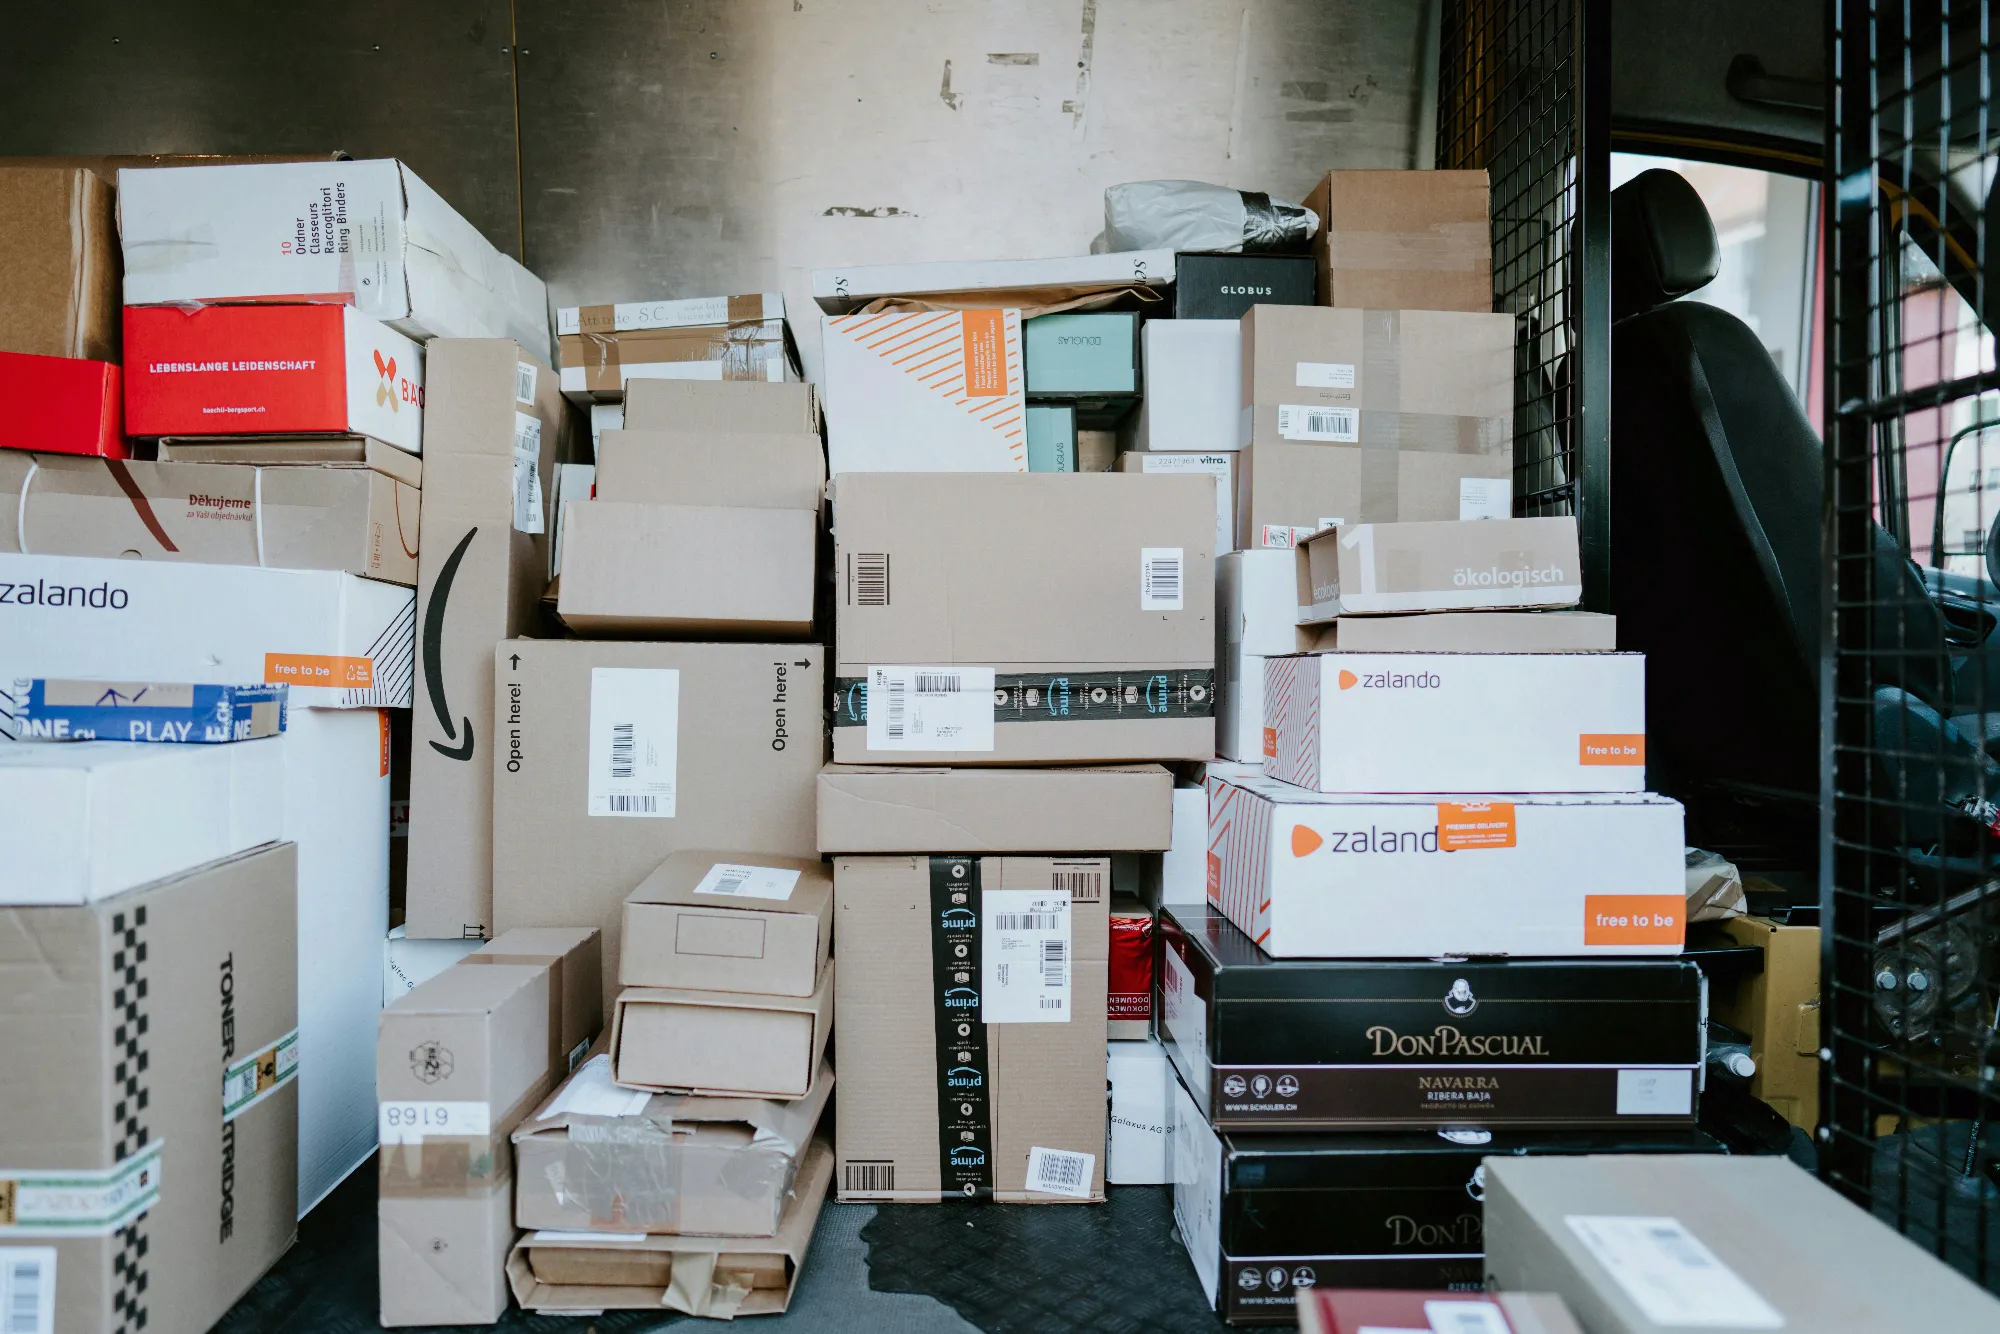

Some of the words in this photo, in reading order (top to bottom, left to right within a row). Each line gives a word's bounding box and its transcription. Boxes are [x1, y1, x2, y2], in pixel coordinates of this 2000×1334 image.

[335, 182, 347, 224] Binders
[309, 202, 321, 255] Classeurs
[320, 187, 335, 254] Raccoglitori
[295, 217, 306, 255] Ordner
[338, 228, 350, 253] Ring
[281, 241, 292, 256] 10
[1220, 285, 1273, 296] GLOBUS
[638, 306, 669, 323] S.C.
[1057, 336, 1101, 346] DOUGLAS
[150, 361, 229, 373] LEBENSLANGE
[232, 360, 316, 371] LEIDENSCHAFT
[1056, 441, 1064, 472] OUGLAS
[1199, 455, 1227, 465] vitra.
[188, 494, 252, 510] Děkujeme
[1453, 565, 1564, 589] ökologisch
[0, 578, 129, 609] zalando
[1313, 580, 1341, 600] écologi
[274, 663, 298, 676] free
[300, 665, 312, 676] to
[315, 664, 330, 676] be
[773, 662, 786, 695] here!
[1362, 670, 1441, 689] zalando
[507, 683, 521, 715] here!
[1059, 677, 1070, 716] prime
[1157, 675, 1168, 713] prime
[129, 720, 193, 742] PLAY
[772, 698, 789, 752] Open
[507, 718, 524, 773] Open
[1586, 745, 1608, 755] free
[1610, 746, 1621, 755] to
[1623, 745, 1637, 755] be
[1332, 825, 1457, 853] zaland
[942, 916, 976, 929] prime
[1595, 913, 1629, 927] free
[1633, 914, 1650, 927] to
[1653, 913, 1674, 927] be
[220, 951, 236, 1062] TONER
[944, 996, 979, 1008] prime
[947, 1075, 982, 1088] prime
[1418, 1076, 1500, 1089] NAVARRA
[1427, 1091, 1465, 1101] RIBERA
[1467, 1091, 1491, 1101] BAJA
[387, 1106, 449, 1127] 6168
[1224, 1103, 1298, 1112] WWW.SCHULER.CH
[1110, 1115, 1147, 1130] Galaxus
[1149, 1125, 1163, 1134] AG
[220, 1068, 236, 1245] TRIDGE
[950, 1154, 985, 1167] prime
